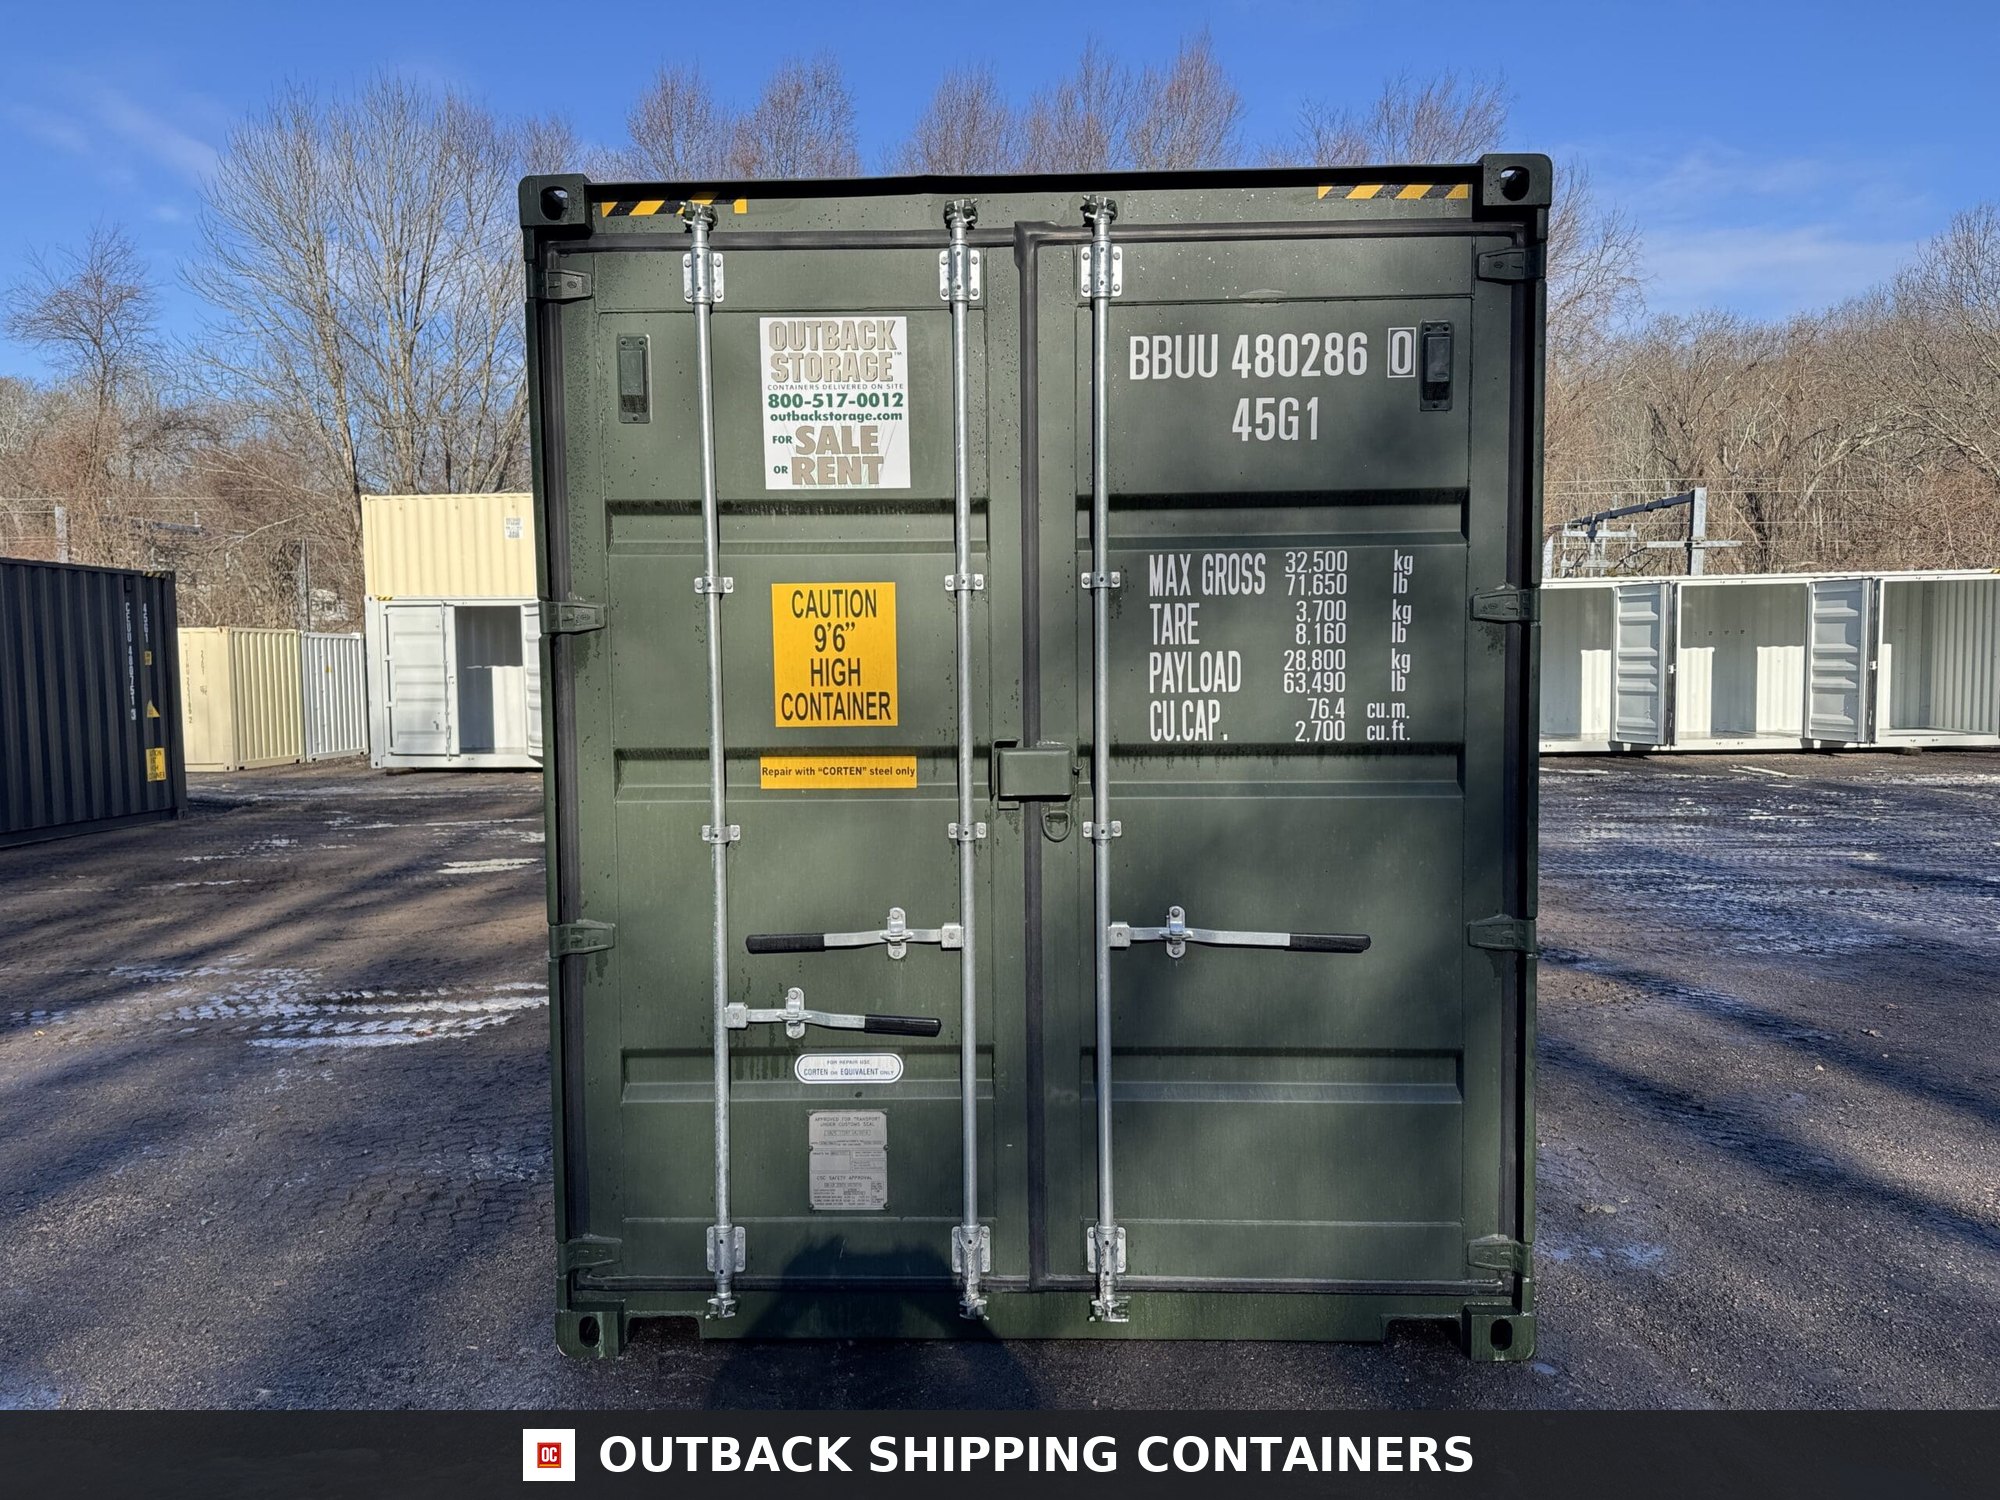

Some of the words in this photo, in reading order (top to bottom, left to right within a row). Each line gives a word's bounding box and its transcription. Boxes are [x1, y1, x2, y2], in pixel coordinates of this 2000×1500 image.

[768, 320, 897, 351] OUTBACK
[770, 352, 893, 382] STORAGE
[1129, 334, 1218, 380] BBUU
[1231, 331, 1368, 378] 480286
[1391, 330, 1412, 375] 0
[768, 392, 904, 408] 800-517-0012
[770, 410, 903, 423] outbackstorage.com
[1231, 396, 1319, 441] 45G1
[772, 435, 793, 444] FOR
[795, 425, 879, 455] SALE
[773, 465, 788, 474] OR
[791, 456, 885, 485] RENT
[1149, 553, 1192, 597] MAX
[1202, 552, 1266, 596] GROSS
[1285, 550, 1348, 574] 32,500
[1393, 549, 1414, 575] kg
[1285, 573, 1347, 596] 71,650
[1392, 572, 1408, 594] lb
[791, 589, 877, 618] CAUTION
[1296, 600, 1347, 623] 3,700
[1392, 599, 1412, 625] kg
[1149, 602, 1200, 645] TARE
[1295, 623, 1346, 645] 8,160
[1391, 622, 1406, 643] lb
[810, 657, 861, 687] HIGH
[1149, 651, 1241, 693] PAYLOAD
[1284, 649, 1346, 672] 28,800
[1391, 648, 1411, 674] kg
[1283, 671, 1346, 695] 63,490
[1391, 670, 1406, 692] lb
[781, 691, 891, 721] CONTAINER
[1150, 699, 1228, 742] CU.CAP.
[1307, 698, 1345, 719] 76.4
[1367, 702, 1410, 719] cu.m.
[1295, 720, 1345, 743] 2,700
[1367, 724, 1411, 742] cu.ft.
[762, 766, 792, 777] Repair
[795, 766, 816, 776] with
[870, 766, 893, 776] steel
[896, 766, 915, 777] only
[803, 1068, 828, 1076] CORTEN
[840, 1068, 879, 1076] EQUIVALENT
